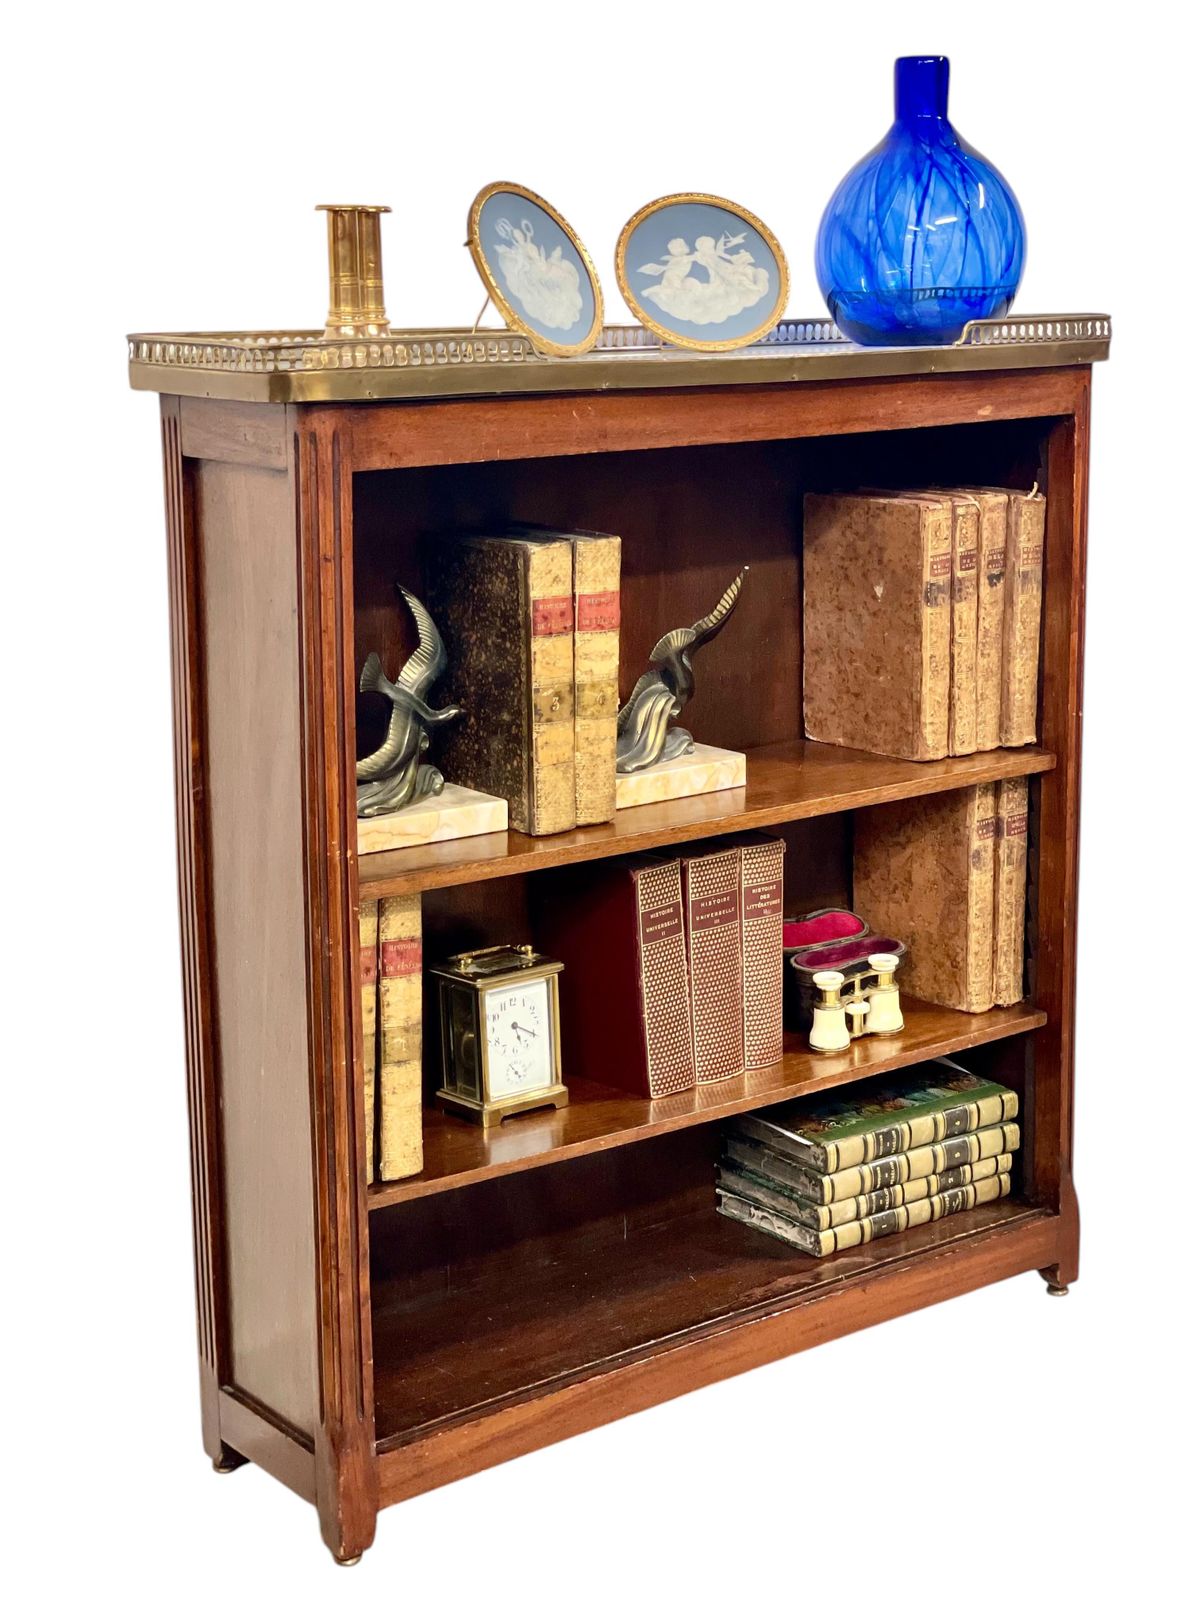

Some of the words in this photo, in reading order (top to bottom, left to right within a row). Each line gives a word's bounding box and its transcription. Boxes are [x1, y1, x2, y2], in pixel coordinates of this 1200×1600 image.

[552, 697, 560, 711] 3
[752, 884, 776, 894] HISTOIRE
[700, 896, 730, 908] HISTOIRE
[650, 907, 674, 919] HISTOIRE
[696, 906, 735, 921] UNIVERSELLE
[645, 918, 679, 933] UNIVERSELLE
[500, 1001, 507, 1011] 11
[509, 997, 517, 1006] 12
[529, 1005, 536, 1015] 2
[492, 1013, 500, 1023] 10
